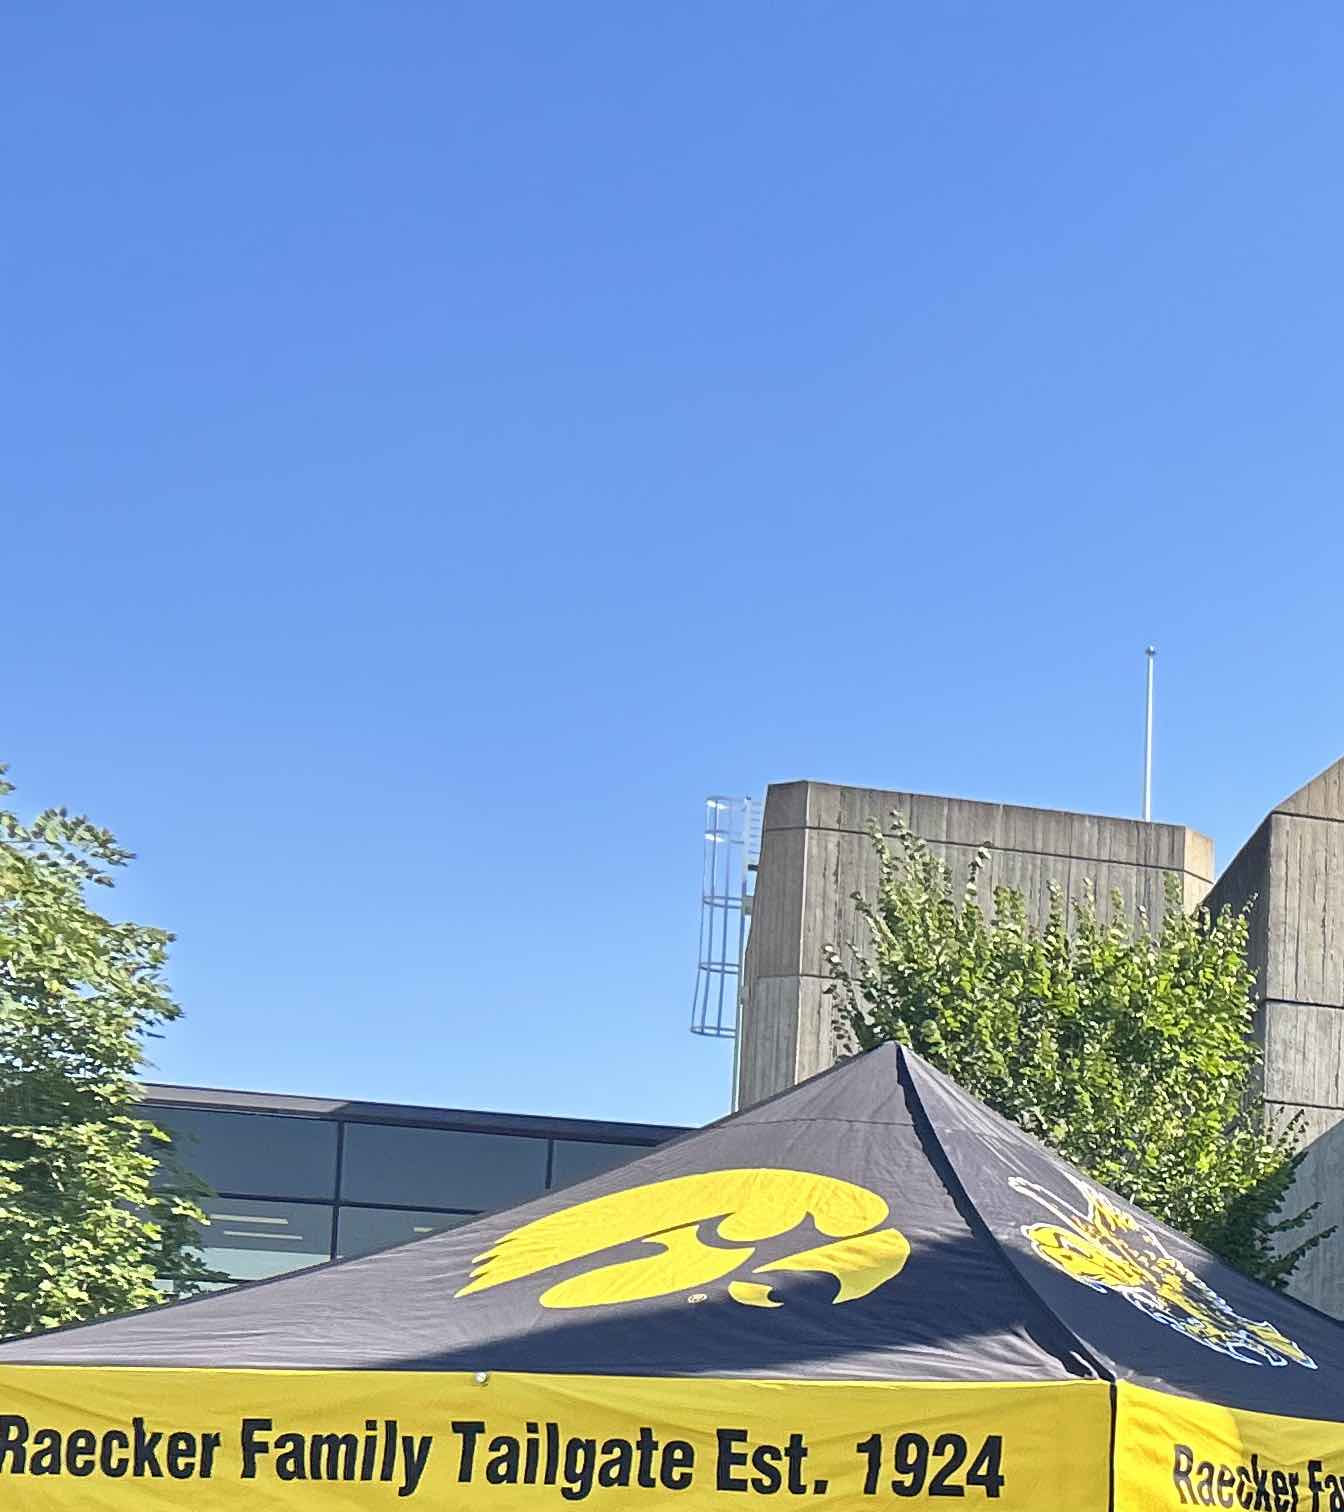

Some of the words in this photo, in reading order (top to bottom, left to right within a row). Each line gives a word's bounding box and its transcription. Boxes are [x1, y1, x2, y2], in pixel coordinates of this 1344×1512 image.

[0, 1414, 221, 1479] Raecker
[240, 1418, 433, 1498] Family
[451, 1421, 695, 1501] Tailgate
[715, 1428, 828, 1495] Est.
[855, 1432, 1005, 1498] 1924
